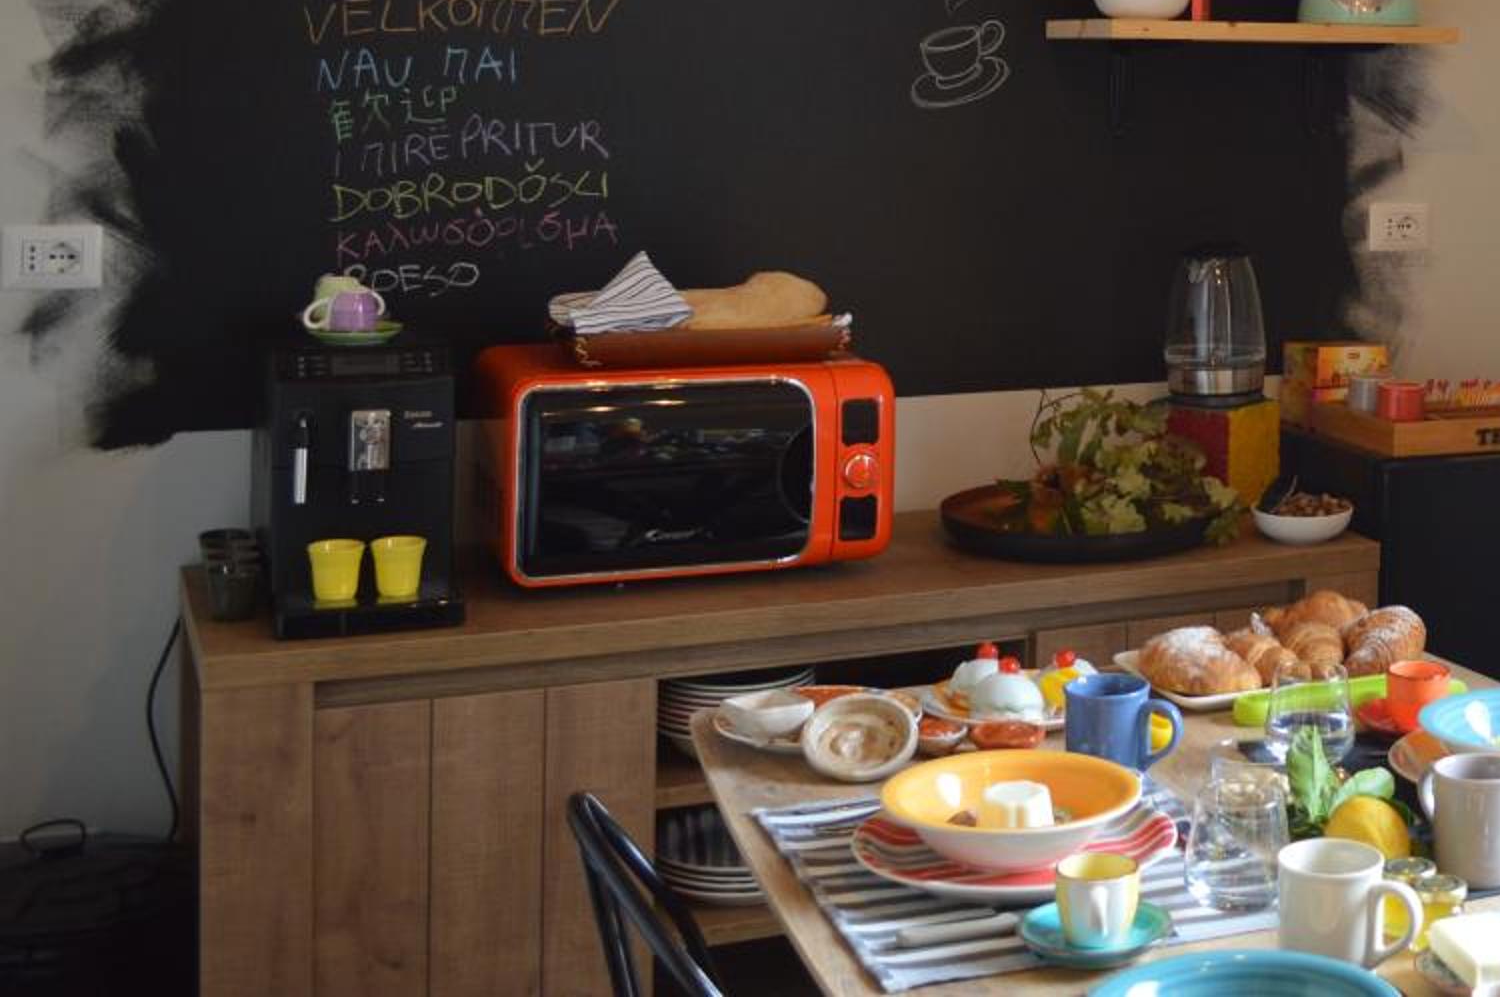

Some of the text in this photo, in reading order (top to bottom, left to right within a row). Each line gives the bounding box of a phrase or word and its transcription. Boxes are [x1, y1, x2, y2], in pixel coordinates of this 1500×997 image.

[316, 46, 519, 91] NAU MAI
[460, 113, 609, 160] PRITUR
